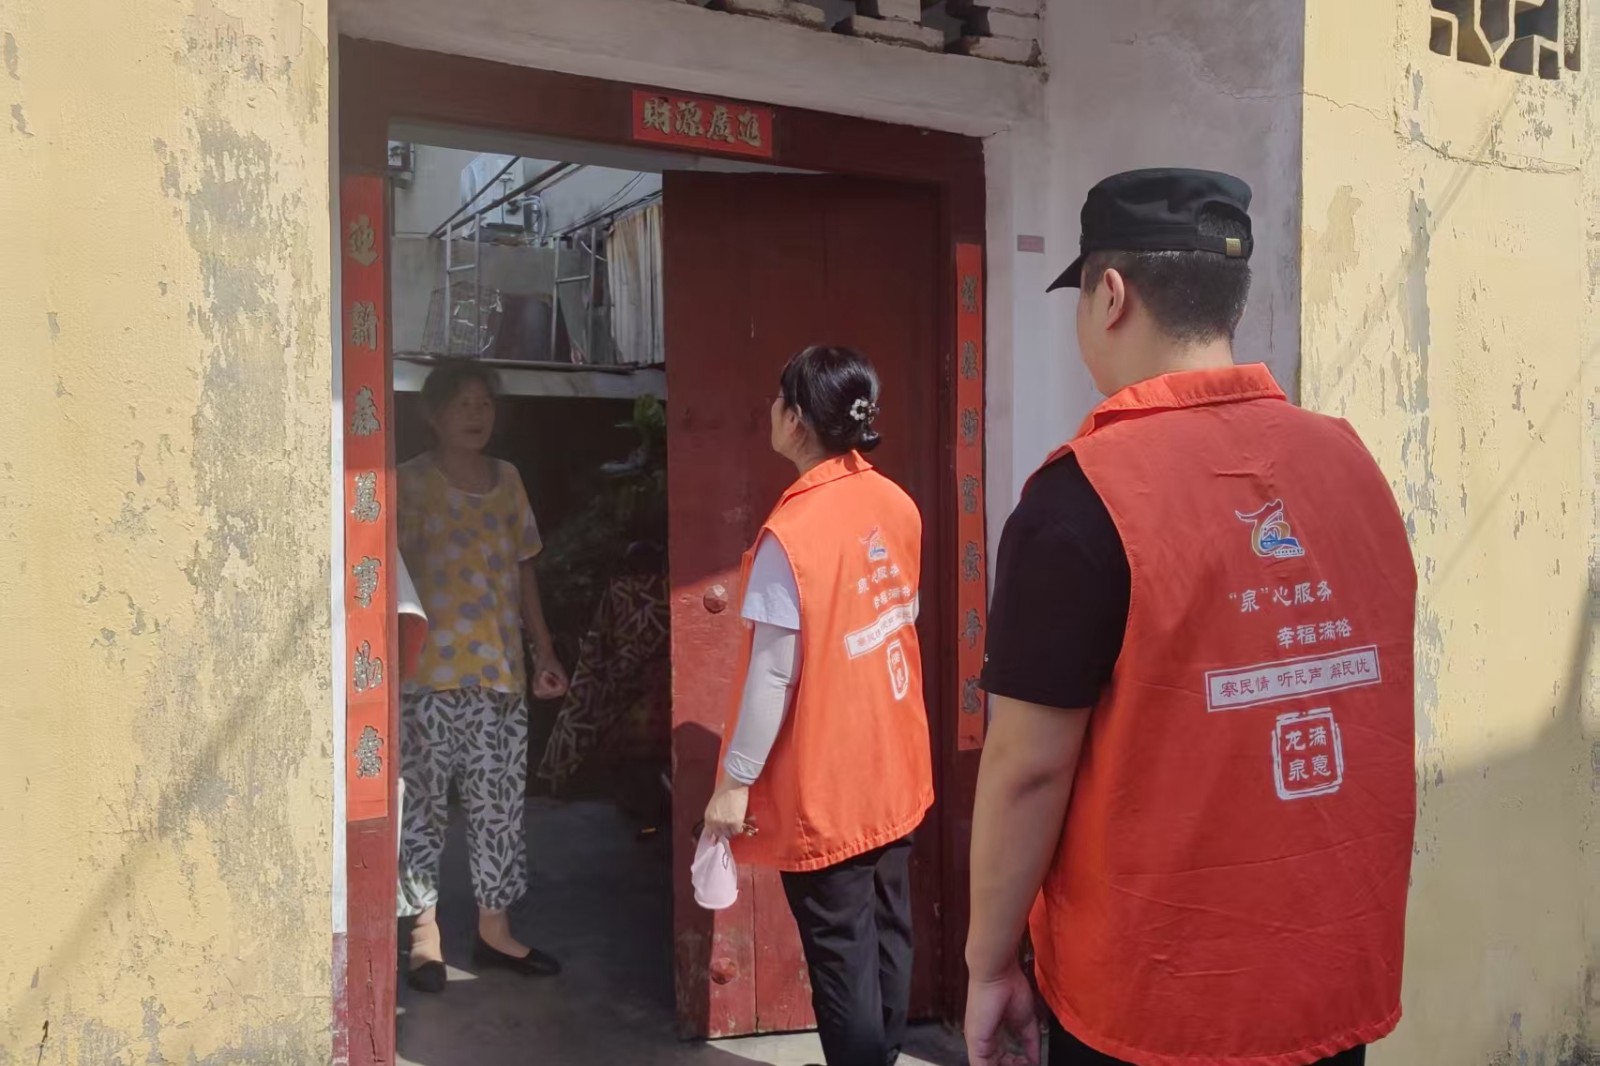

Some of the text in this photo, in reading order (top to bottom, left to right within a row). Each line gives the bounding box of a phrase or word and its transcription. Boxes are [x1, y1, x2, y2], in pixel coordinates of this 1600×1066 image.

[1277, 617, 1352, 648] 幸福满格
[1220, 676, 1270, 697] 察民情
[1277, 667, 1322, 688] 听民声
